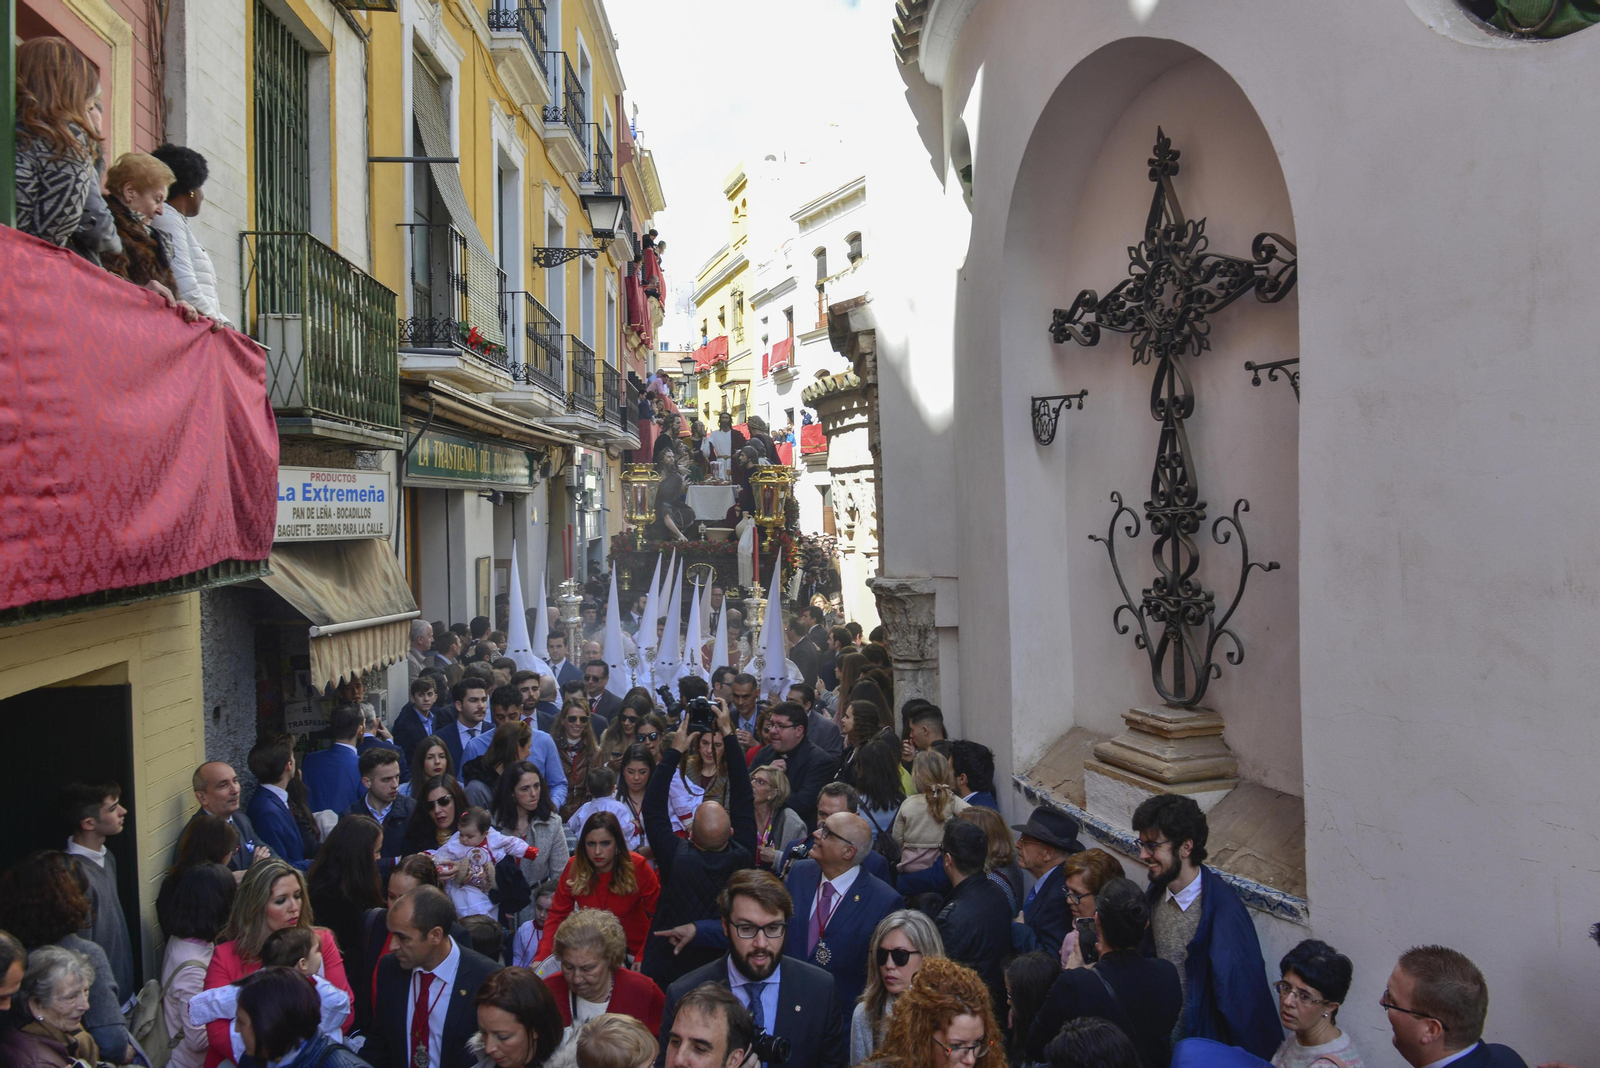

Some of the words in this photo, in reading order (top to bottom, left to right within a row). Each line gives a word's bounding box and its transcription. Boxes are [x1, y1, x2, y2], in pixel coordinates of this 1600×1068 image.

[418, 438, 429, 467] LA
[434, 440, 477, 472] TRASTIENDA
[480, 449, 491, 474] DEL
[310, 472, 357, 483] PRODUCTOS
[277, 482, 296, 501] La
[302, 483, 385, 502] Extremeña
[292, 507, 305, 519] PAN
[306, 507, 315, 519] DE
[316, 505, 332, 519] LEÑA
[337, 507, 372, 519] BOCADILLOS
[278, 524, 311, 537] BAGUETTE
[316, 523, 341, 536] BEBIDAS
[342, 523, 357, 535] PARA
[358, 522, 366, 533] LA
[366, 522, 384, 534] CALLE
[287, 719, 326, 729] TRASPASA
